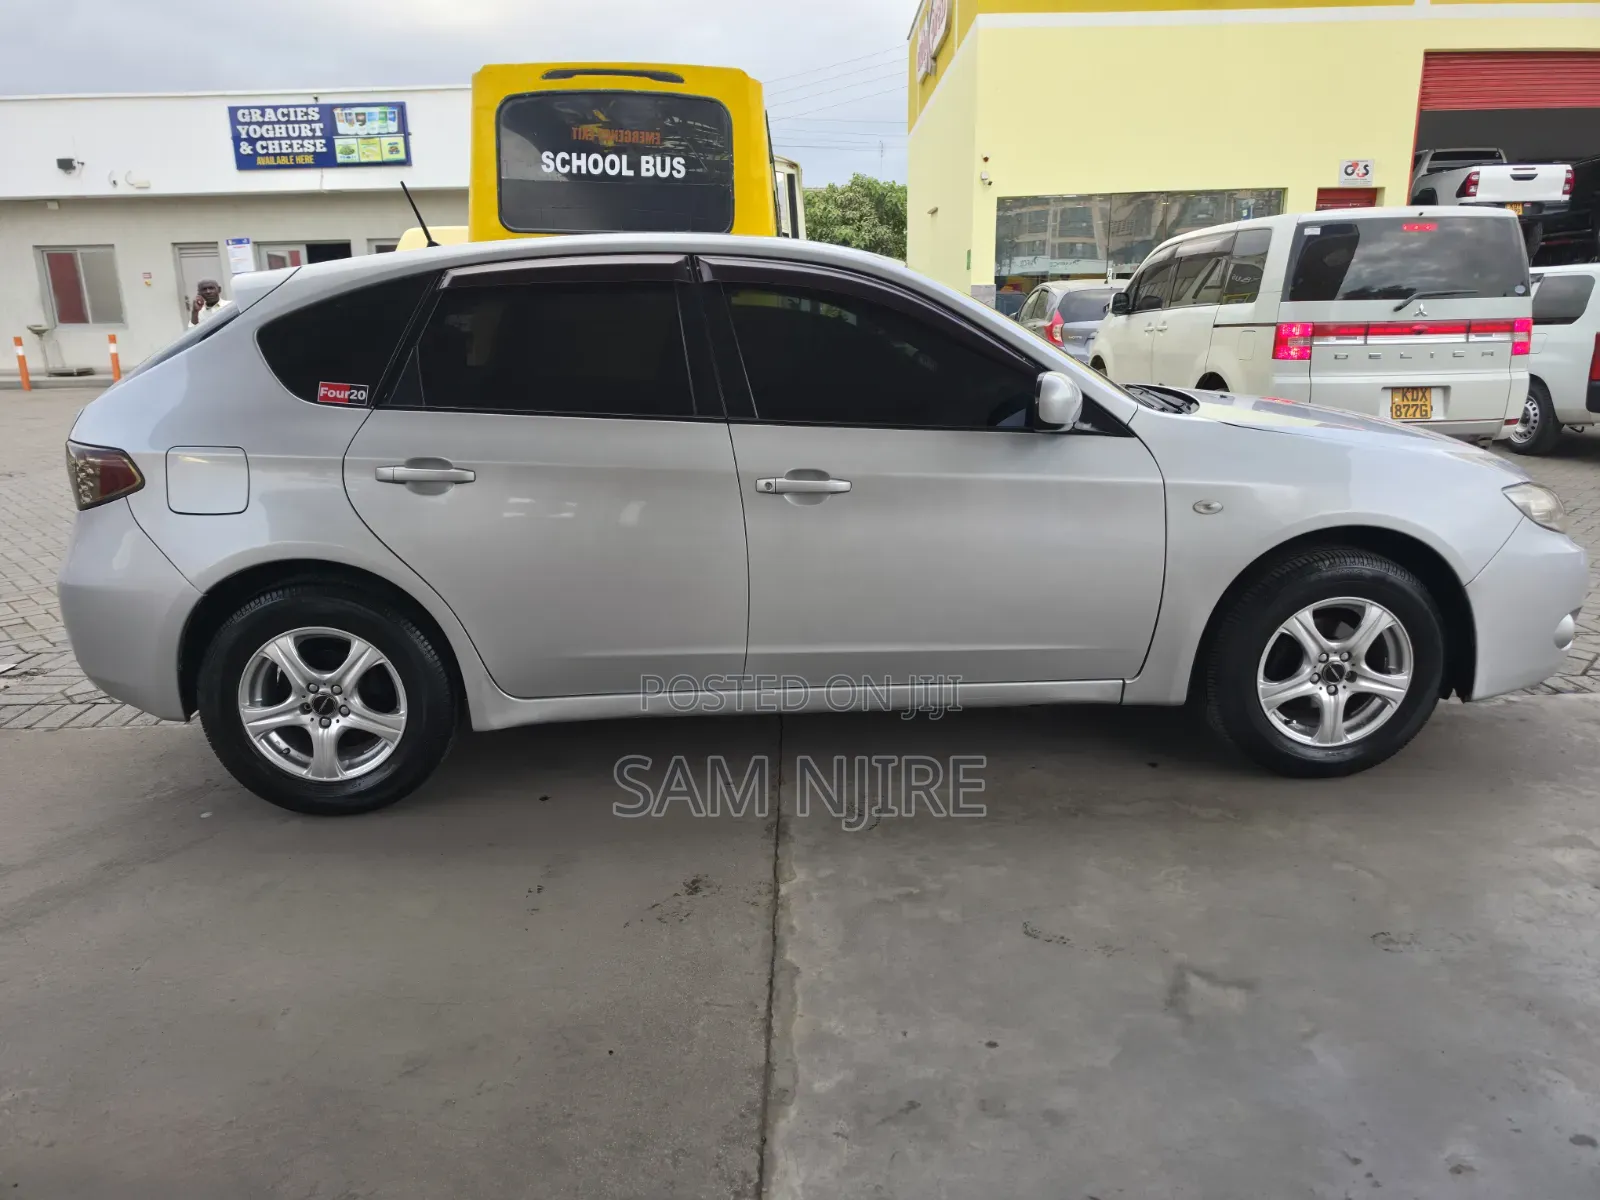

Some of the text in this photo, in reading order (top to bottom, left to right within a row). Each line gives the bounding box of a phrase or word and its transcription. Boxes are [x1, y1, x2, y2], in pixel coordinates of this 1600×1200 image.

[237, 107, 320, 122] GRACIES
[236, 123, 324, 138] YOGHURT
[239, 139, 328, 155] & CHEESE
[256, 154, 315, 165] AVAILABLE HERE
[541, 151, 686, 179] SCHOOL BUS
[1344, 162, 1370, 177] G4S
[1334, 350, 1494, 360] DELICA
[320, 386, 366, 400] Four20
[1401, 387, 1428, 402] KDX
[1394, 404, 1429, 418] 877G
